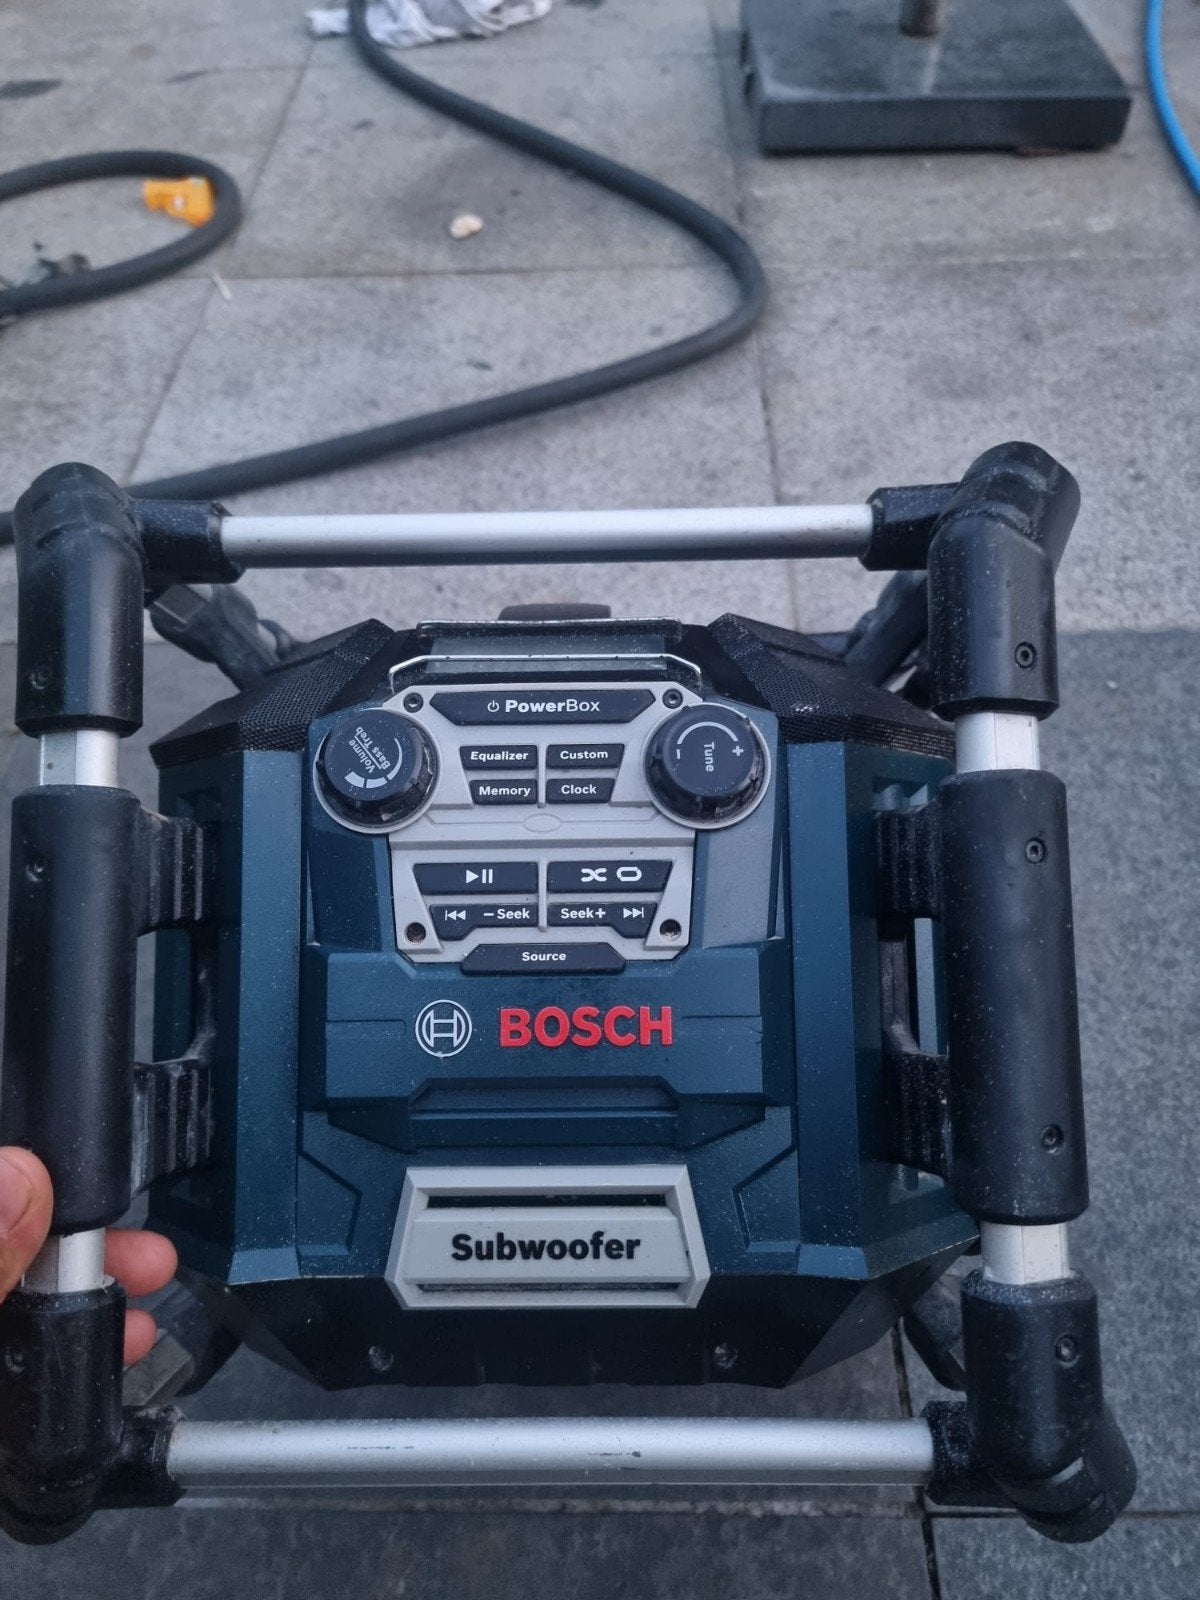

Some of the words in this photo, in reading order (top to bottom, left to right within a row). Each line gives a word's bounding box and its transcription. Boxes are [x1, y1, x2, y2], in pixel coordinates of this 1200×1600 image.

[505, 698, 600, 713] PowerBox
[355, 726, 372, 749] Treb
[348, 739, 376, 774] Volume
[371, 746, 391, 770] Bass
[470, 751, 529, 763] Equalizer
[560, 749, 609, 760] Custom
[703, 741, 715, 773] Tune
[479, 786, 531, 797] Memory
[561, 784, 597, 795] Clock
[521, 951, 567, 962] Source
[500, 1006, 673, 1047] BOSCH
[451, 1231, 641, 1261] Subwoofer
